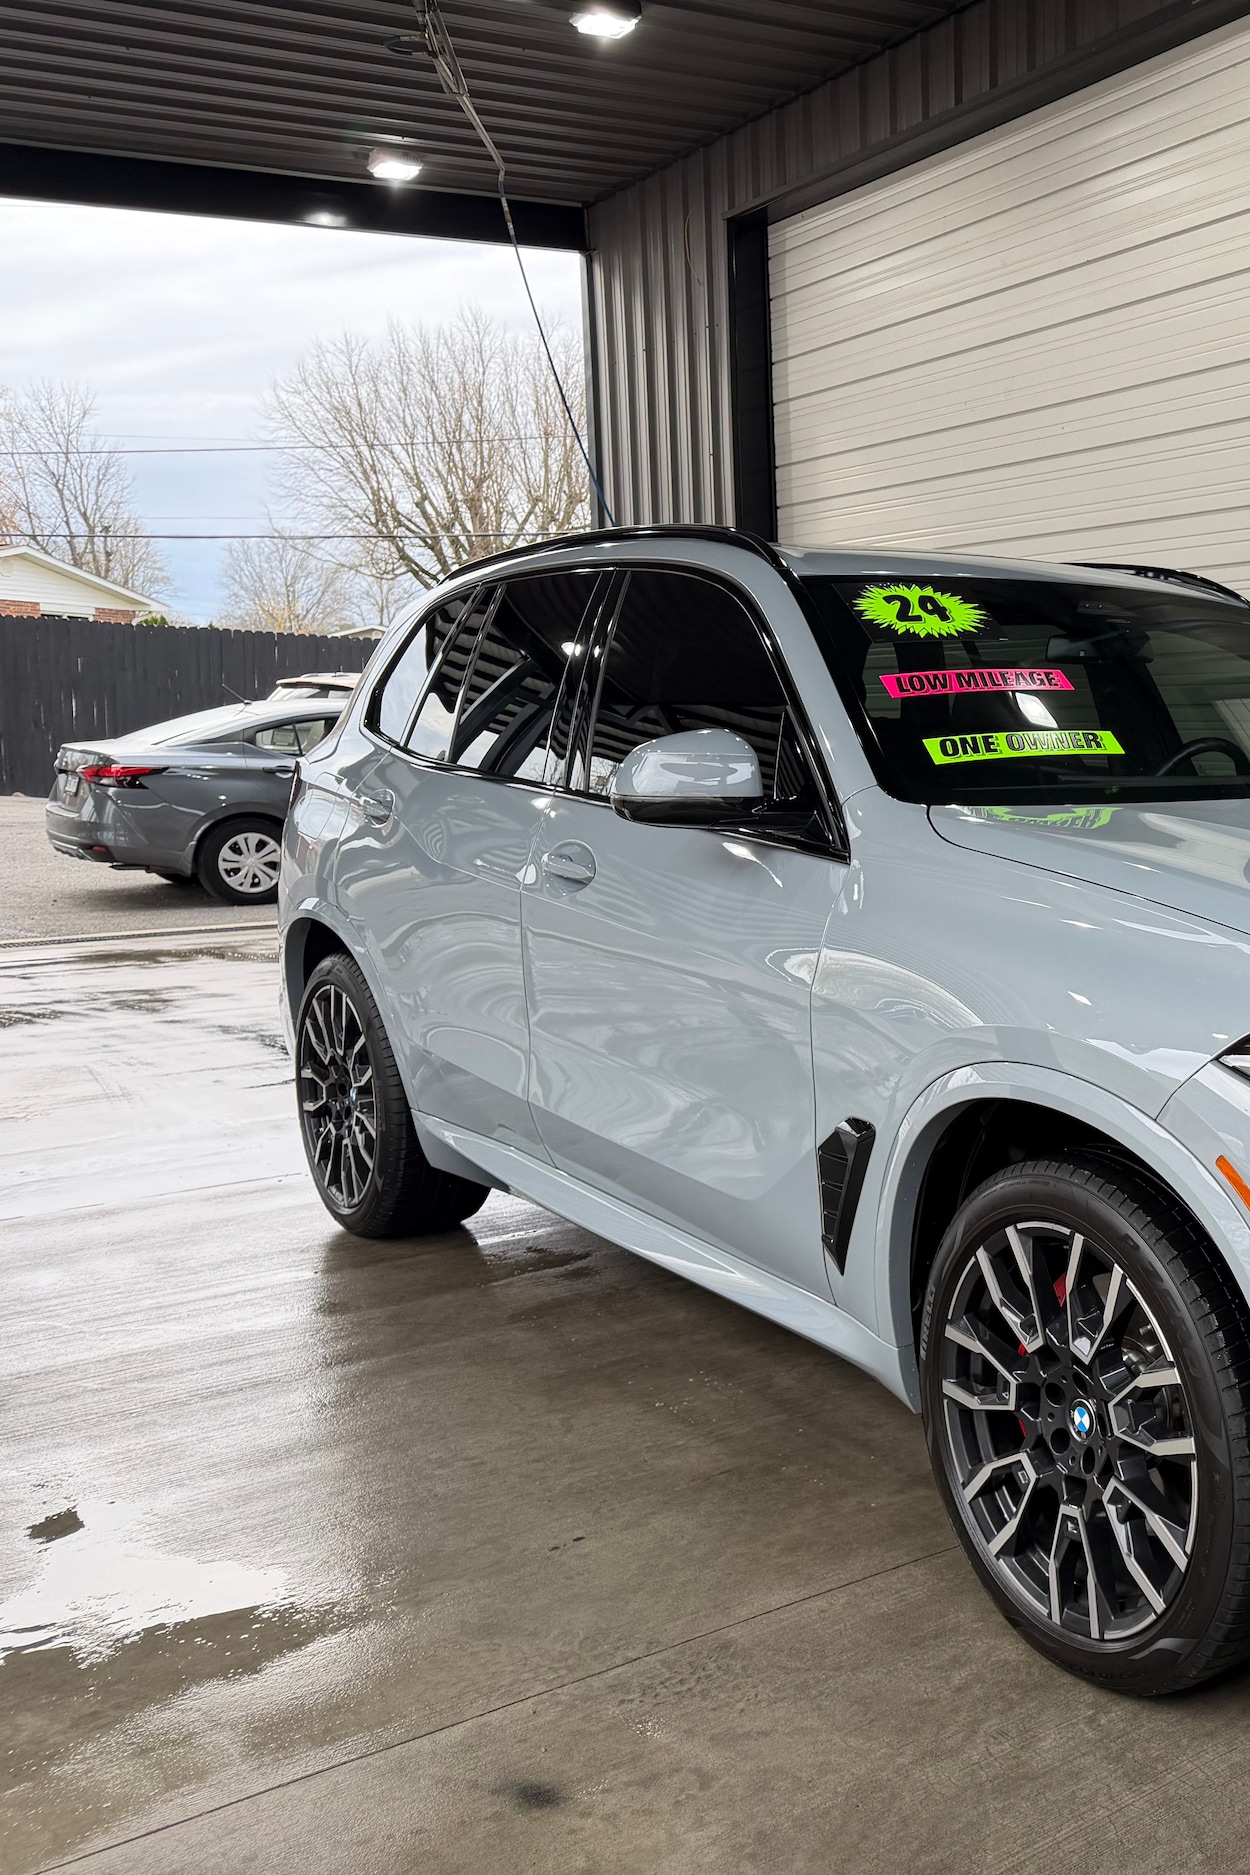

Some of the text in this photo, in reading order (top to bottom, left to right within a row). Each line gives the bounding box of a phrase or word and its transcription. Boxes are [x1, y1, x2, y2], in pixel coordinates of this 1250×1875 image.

[882, 594, 954, 623] 24
[895, 671, 1061, 694] LOW MILEAGE
[939, 731, 1105, 758] ONE OWNER
